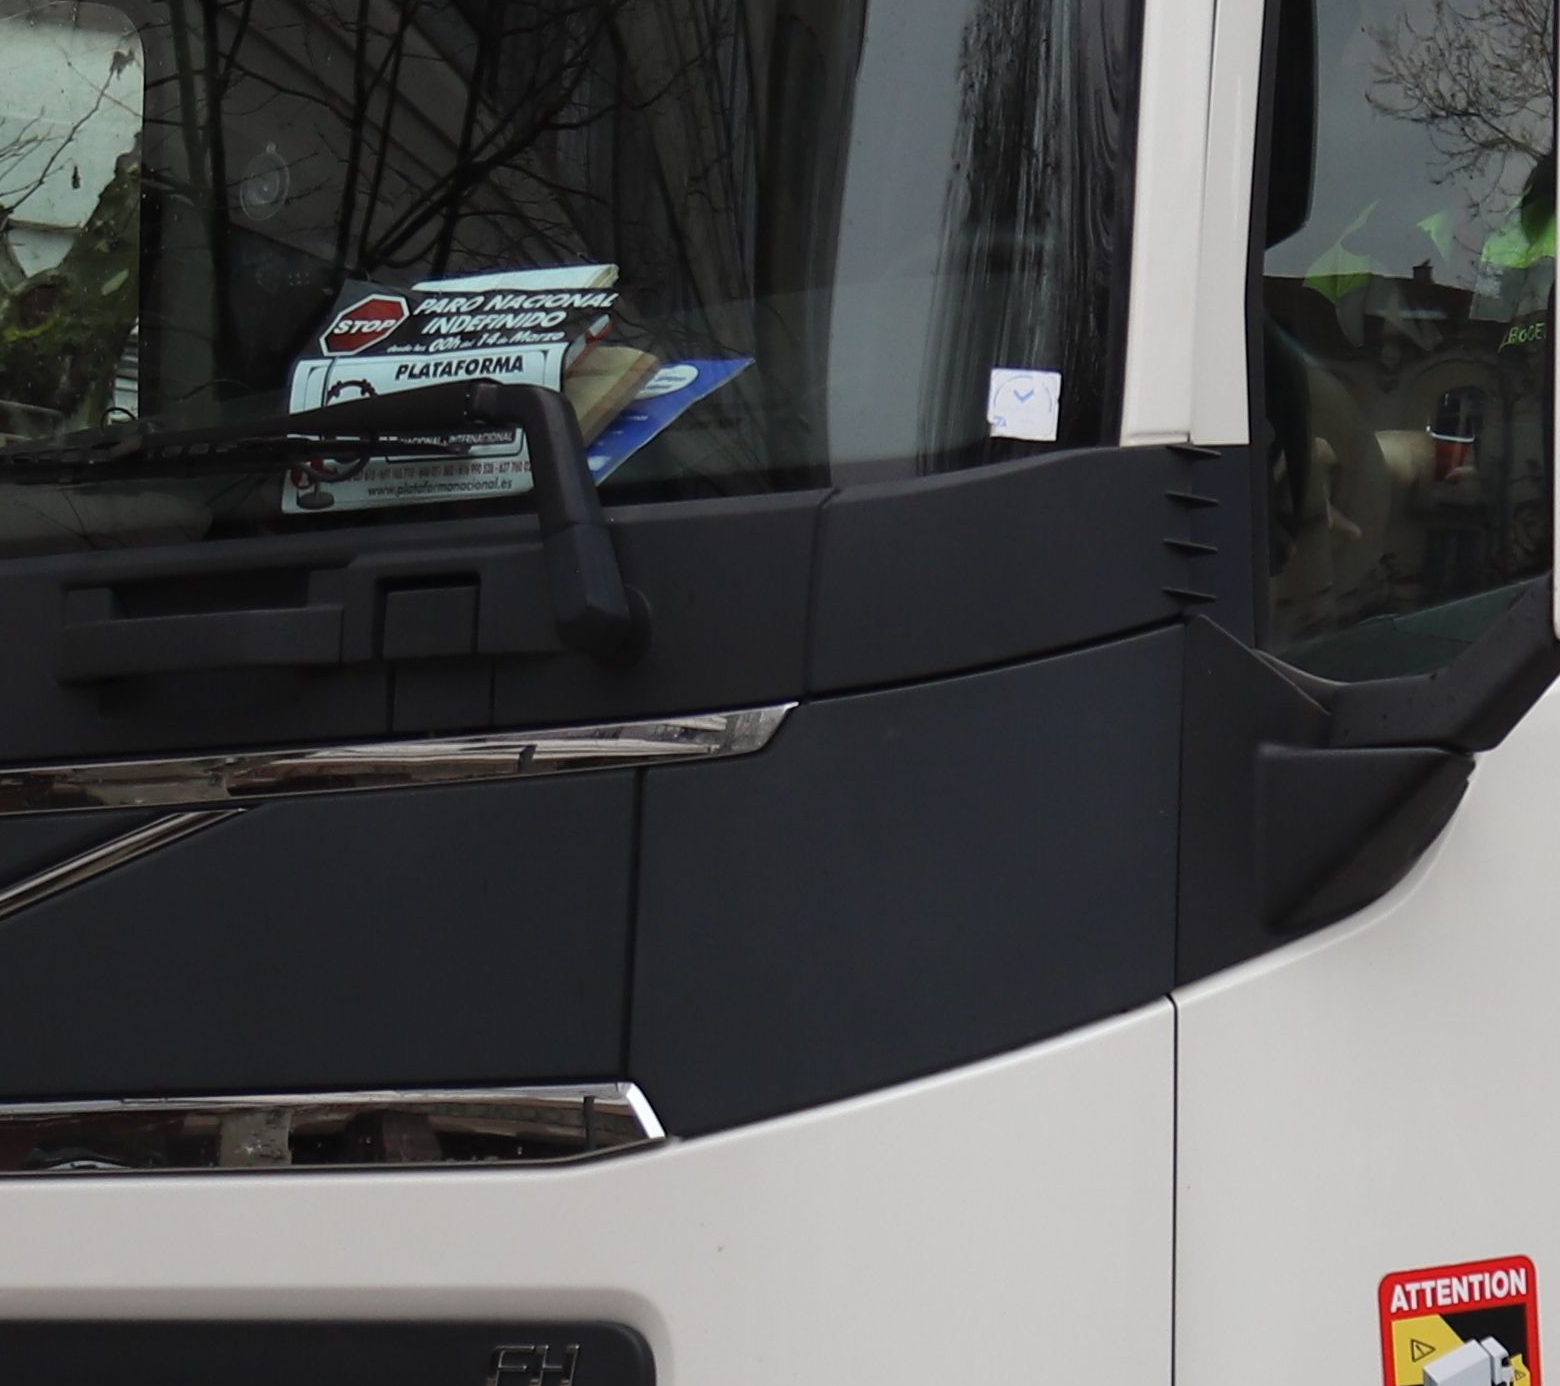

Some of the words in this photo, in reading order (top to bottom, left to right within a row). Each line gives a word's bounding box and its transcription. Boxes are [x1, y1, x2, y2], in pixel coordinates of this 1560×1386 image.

[413, 295, 484, 315] PARO
[484, 293, 619, 311] NACIONAL
[332, 318, 395, 335] STOP
[421, 312, 567, 335] INDEFINIDO
[428, 335, 461, 353] 00h
[476, 333, 499, 348] 14
[508, 330, 566, 344] Marzo
[395, 354, 524, 381] PLATAFORMA
[448, 432, 513, 444] INTERNACIONAL
[367, 477, 513, 497] www.plataformanacional.es
[1391, 1268, 1527, 1314] ATTENTION
